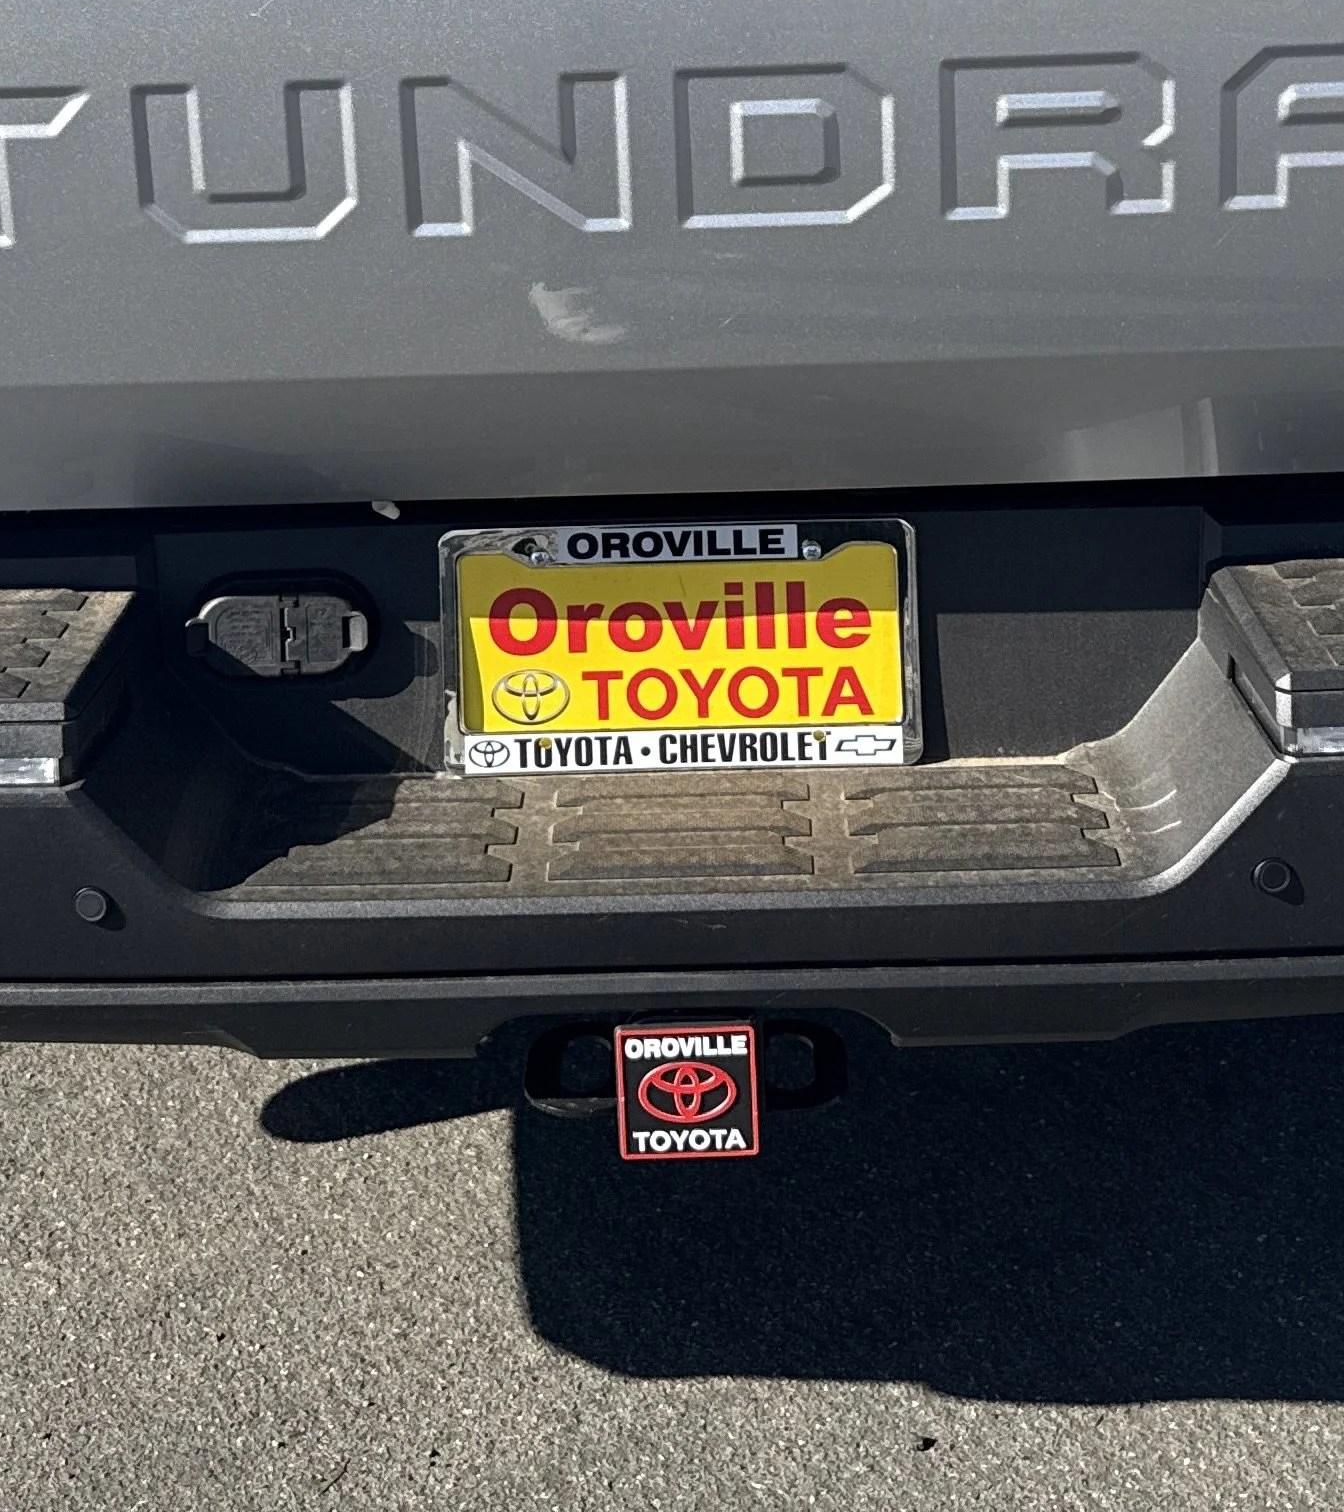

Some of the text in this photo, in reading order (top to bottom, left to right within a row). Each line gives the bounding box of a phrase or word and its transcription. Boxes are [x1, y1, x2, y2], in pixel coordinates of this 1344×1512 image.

[566, 528, 784, 560] OROVILLE
[488, 581, 872, 656] Oroville
[582, 666, 874, 720] TOYOTA
[514, 730, 831, 769] TOYOTA CHEVROLET
[624, 1034, 748, 1059] OROVILLE
[632, 1128, 746, 1153] TOYOTA
